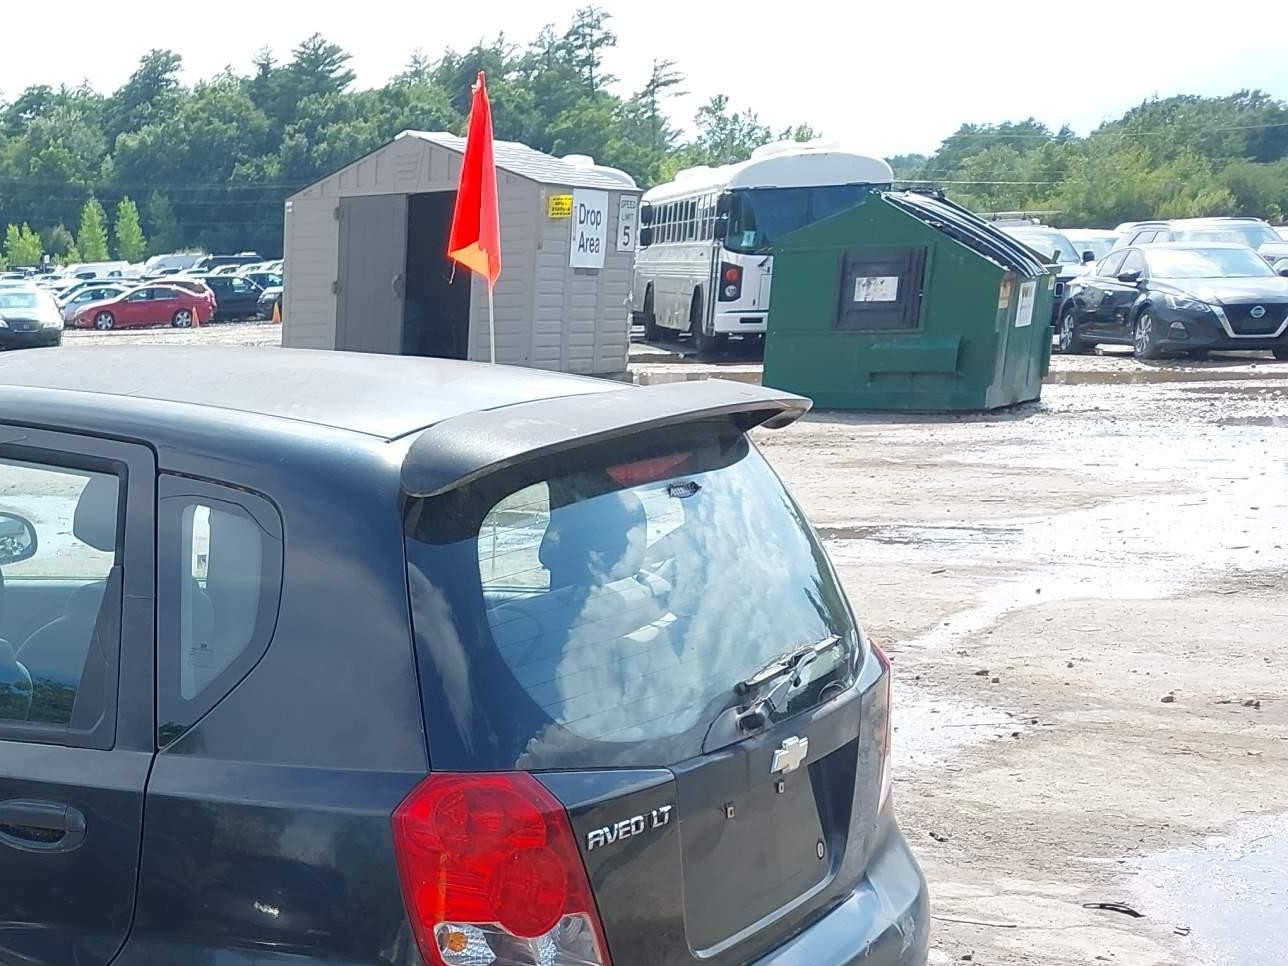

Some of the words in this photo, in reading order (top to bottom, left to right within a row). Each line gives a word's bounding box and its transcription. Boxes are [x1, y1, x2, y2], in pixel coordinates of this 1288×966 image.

[621, 200, 636, 209] SPEED
[579, 203, 602, 231] Drop
[578, 231, 600, 254] Area
[623, 226, 630, 246] 5
[587, 815, 644, 851] AVEO
[651, 805, 672, 829] LT
